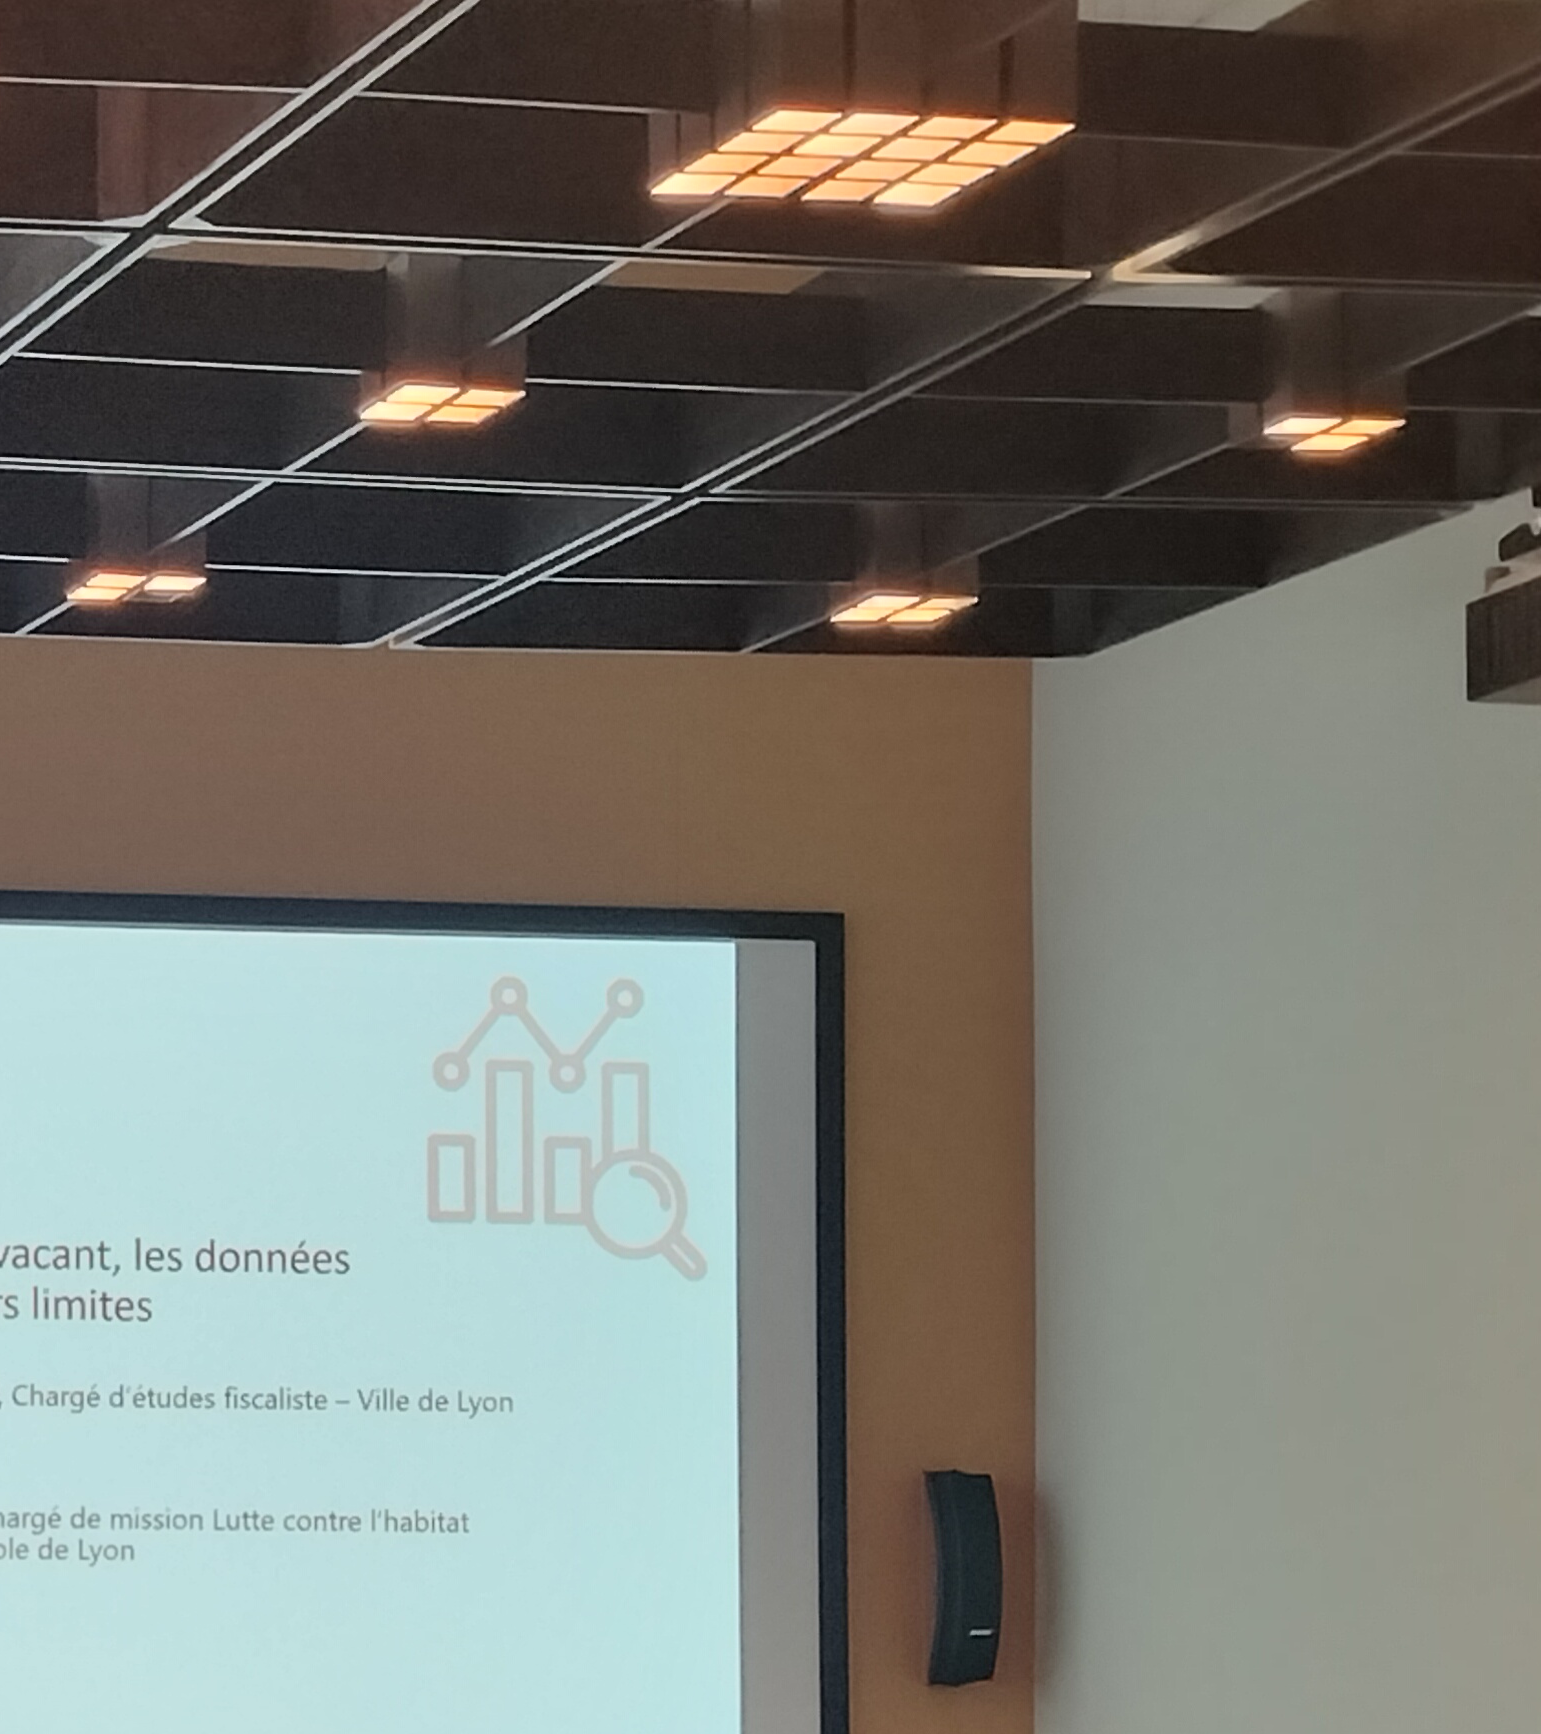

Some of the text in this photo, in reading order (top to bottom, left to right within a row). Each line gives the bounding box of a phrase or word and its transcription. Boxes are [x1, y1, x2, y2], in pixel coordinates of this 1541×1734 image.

[135, 1238, 182, 1272] les
[196, 1239, 350, 1274] données
[34, 1286, 152, 1322] limites
[12, 1384, 100, 1413] Chargé
[225, 1386, 327, 1410] fiscaliste
[357, 1388, 409, 1411] Ville
[418, 1388, 449, 1412] de
[458, 1391, 513, 1418] Lyon
[70, 1506, 101, 1529] de
[111, 1508, 203, 1530] mission
[214, 1509, 274, 1531] Lutte
[283, 1512, 361, 1532] contre
[38, 1537, 68, 1560] de
[79, 1539, 134, 1567] Lyon
